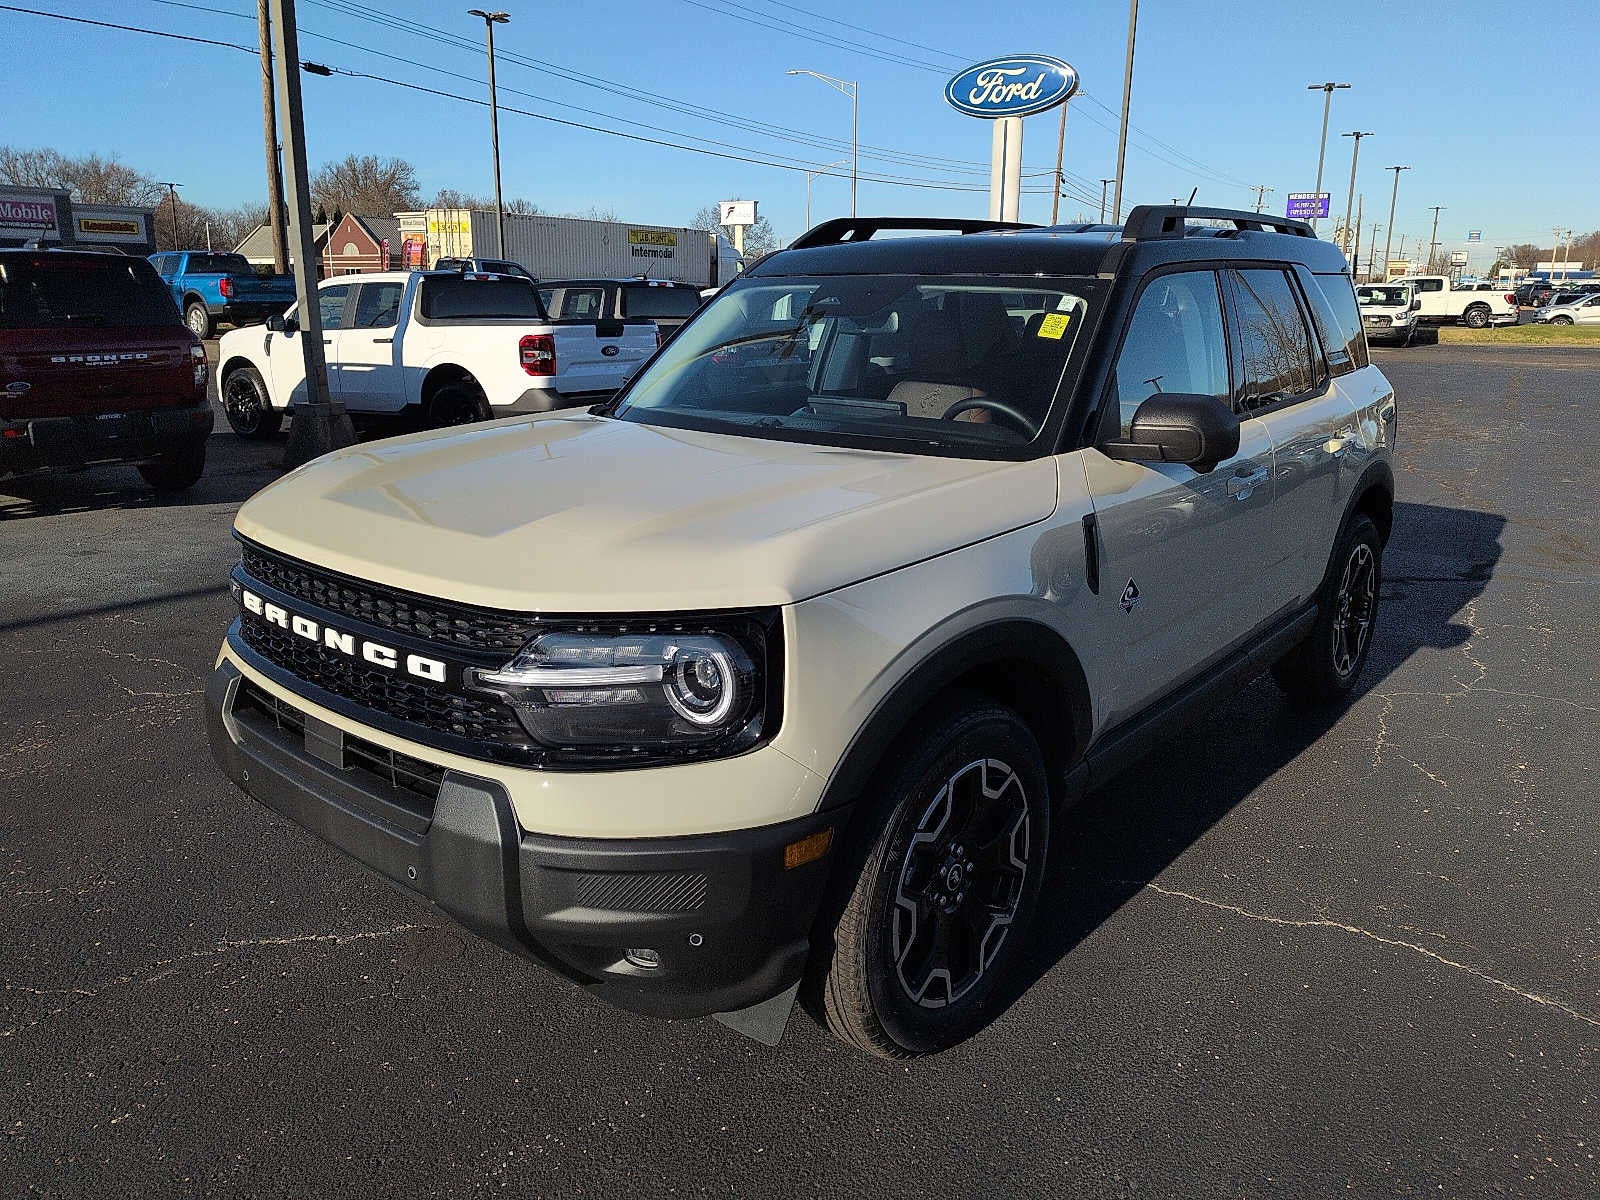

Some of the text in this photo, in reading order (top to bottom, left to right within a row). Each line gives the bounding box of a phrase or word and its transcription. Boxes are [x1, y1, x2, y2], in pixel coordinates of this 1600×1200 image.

[969, 67, 1046, 105] Ford
[631, 246, 675, 259] Intermodal
[51, 353, 148, 363] BRONCO
[243, 590, 447, 683] BRONCO
